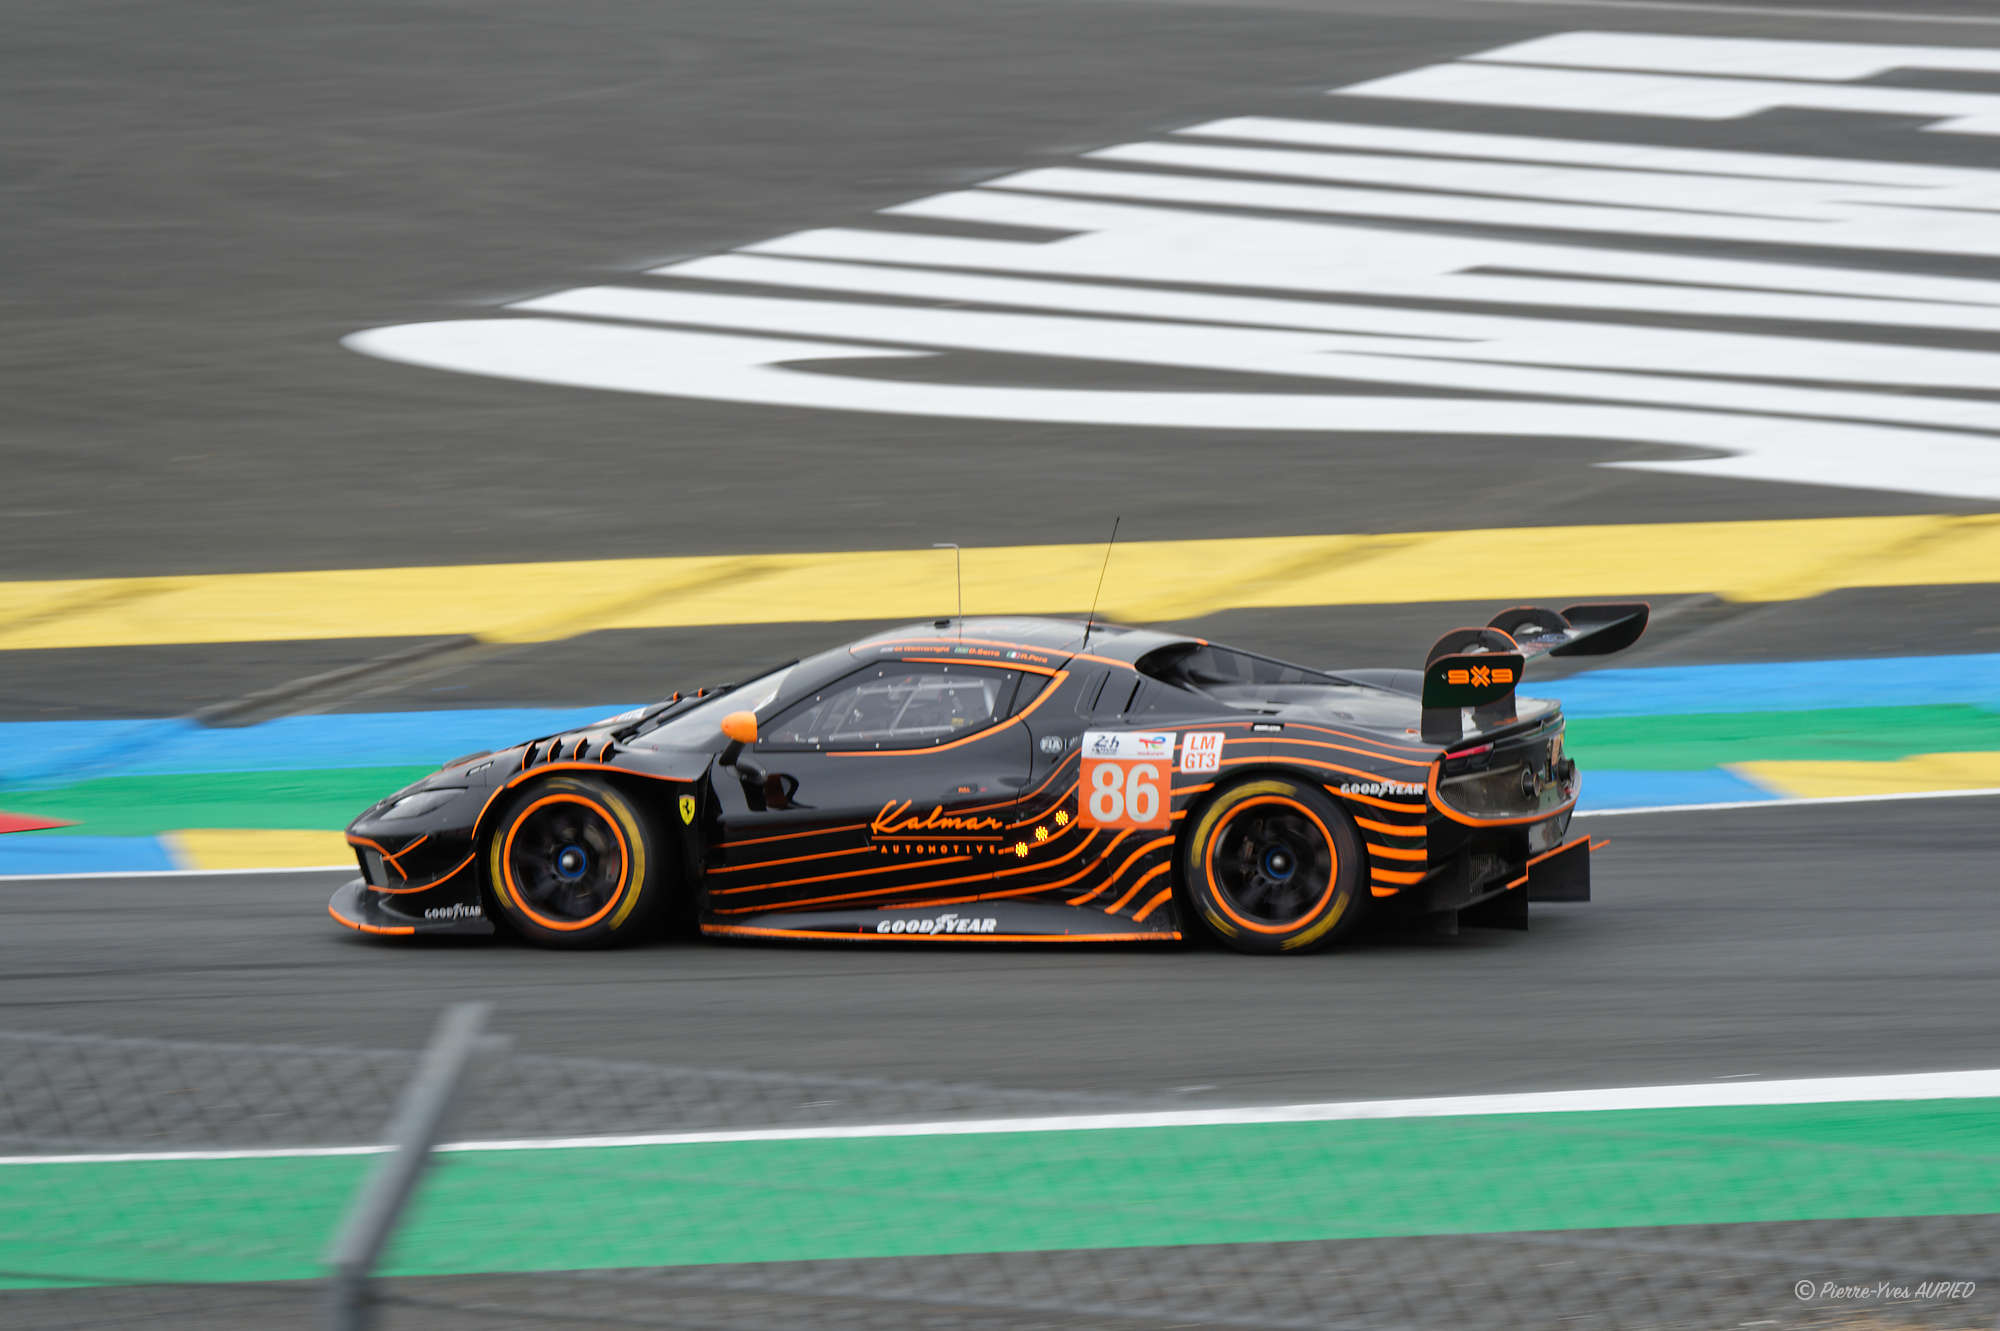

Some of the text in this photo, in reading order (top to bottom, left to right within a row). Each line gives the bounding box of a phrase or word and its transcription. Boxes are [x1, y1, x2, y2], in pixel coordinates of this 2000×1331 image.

[1190, 735, 1216, 750] LM
[1184, 752, 1216, 769] GT3
[1089, 762, 1160, 822] 86
[1340, 780, 1425, 797] GOODYEAR
[871, 799, 1003, 835] Kalmar
[880, 844, 995, 855] AUTOMOTIVE
[424, 902, 482, 920] GOODYEAR
[877, 913, 998, 935] GOODYEAR
